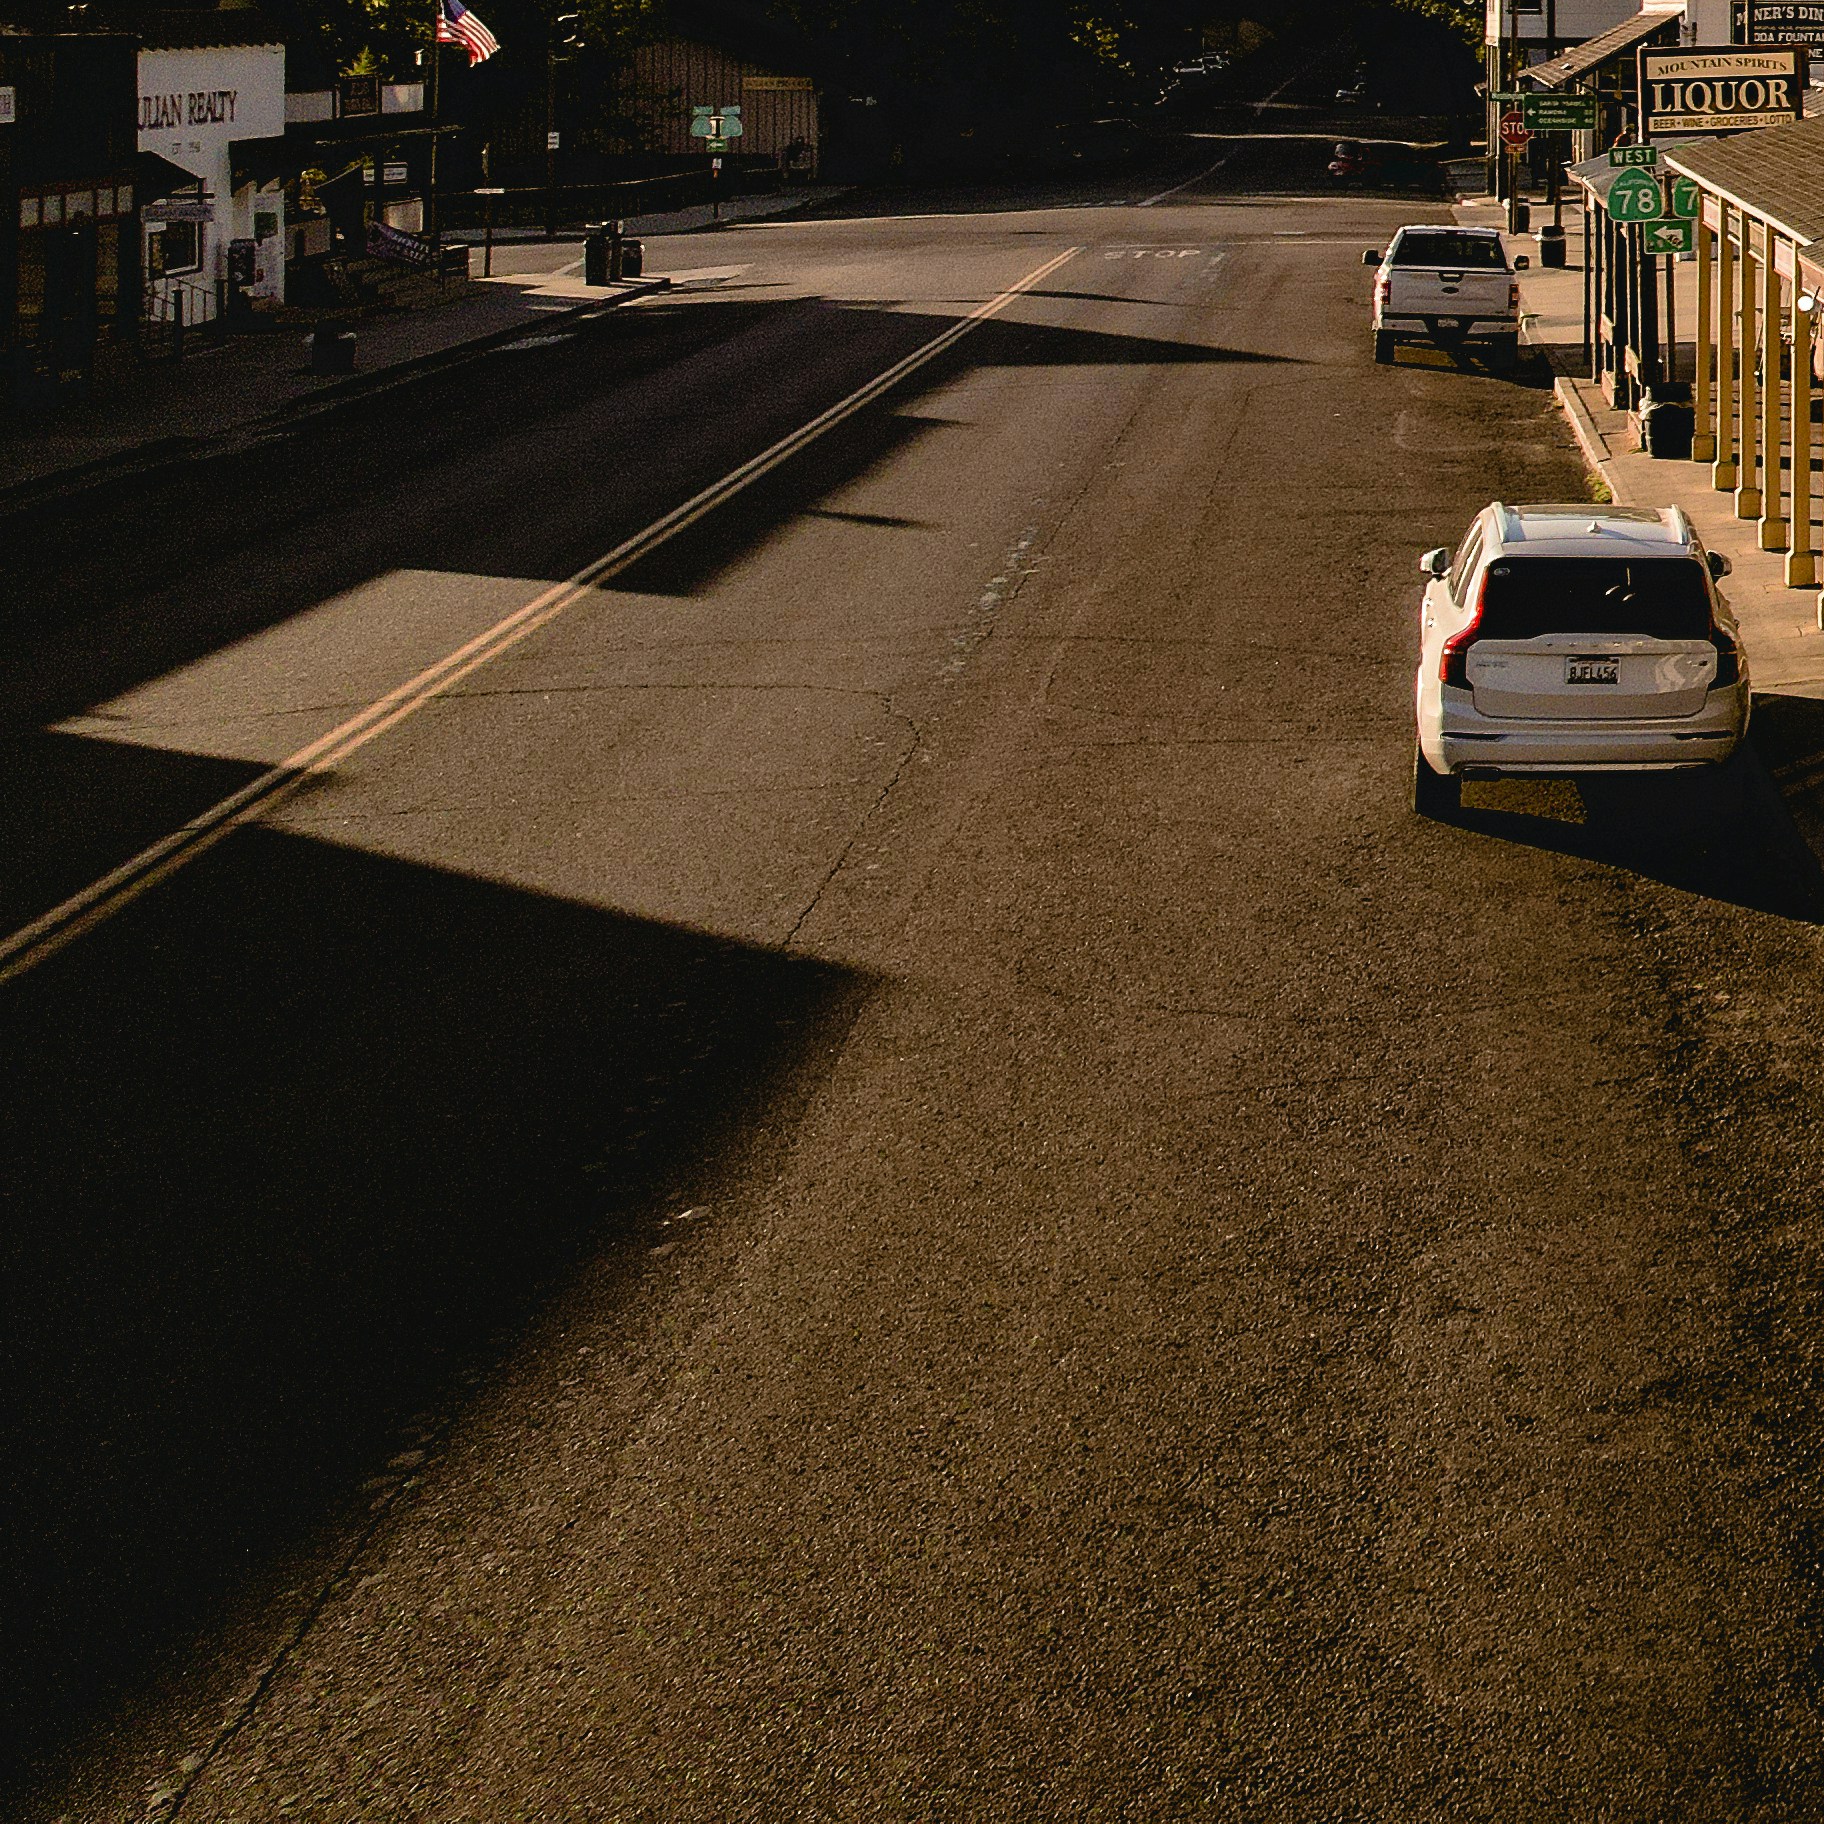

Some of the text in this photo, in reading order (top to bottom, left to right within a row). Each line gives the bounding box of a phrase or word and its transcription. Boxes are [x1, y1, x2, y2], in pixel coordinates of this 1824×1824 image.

[1736, 6, 1795, 26] MNER'S
[1658, 57, 1787, 76] MOUNTAIN SPIRITS
[1651, 79, 1791, 114] LIQUOR
[188, 90, 238, 126] REALTY
[1502, 121, 1528, 135] STO
[1653, 114, 1792, 129] BEER WINE GROCERIES LOTTO
[1613, 149, 1653, 164] WEST
[1615, 188, 1656, 215] 78
[1681, 185, 1699, 211] 7
[1103, 249, 1201, 260] STOP
